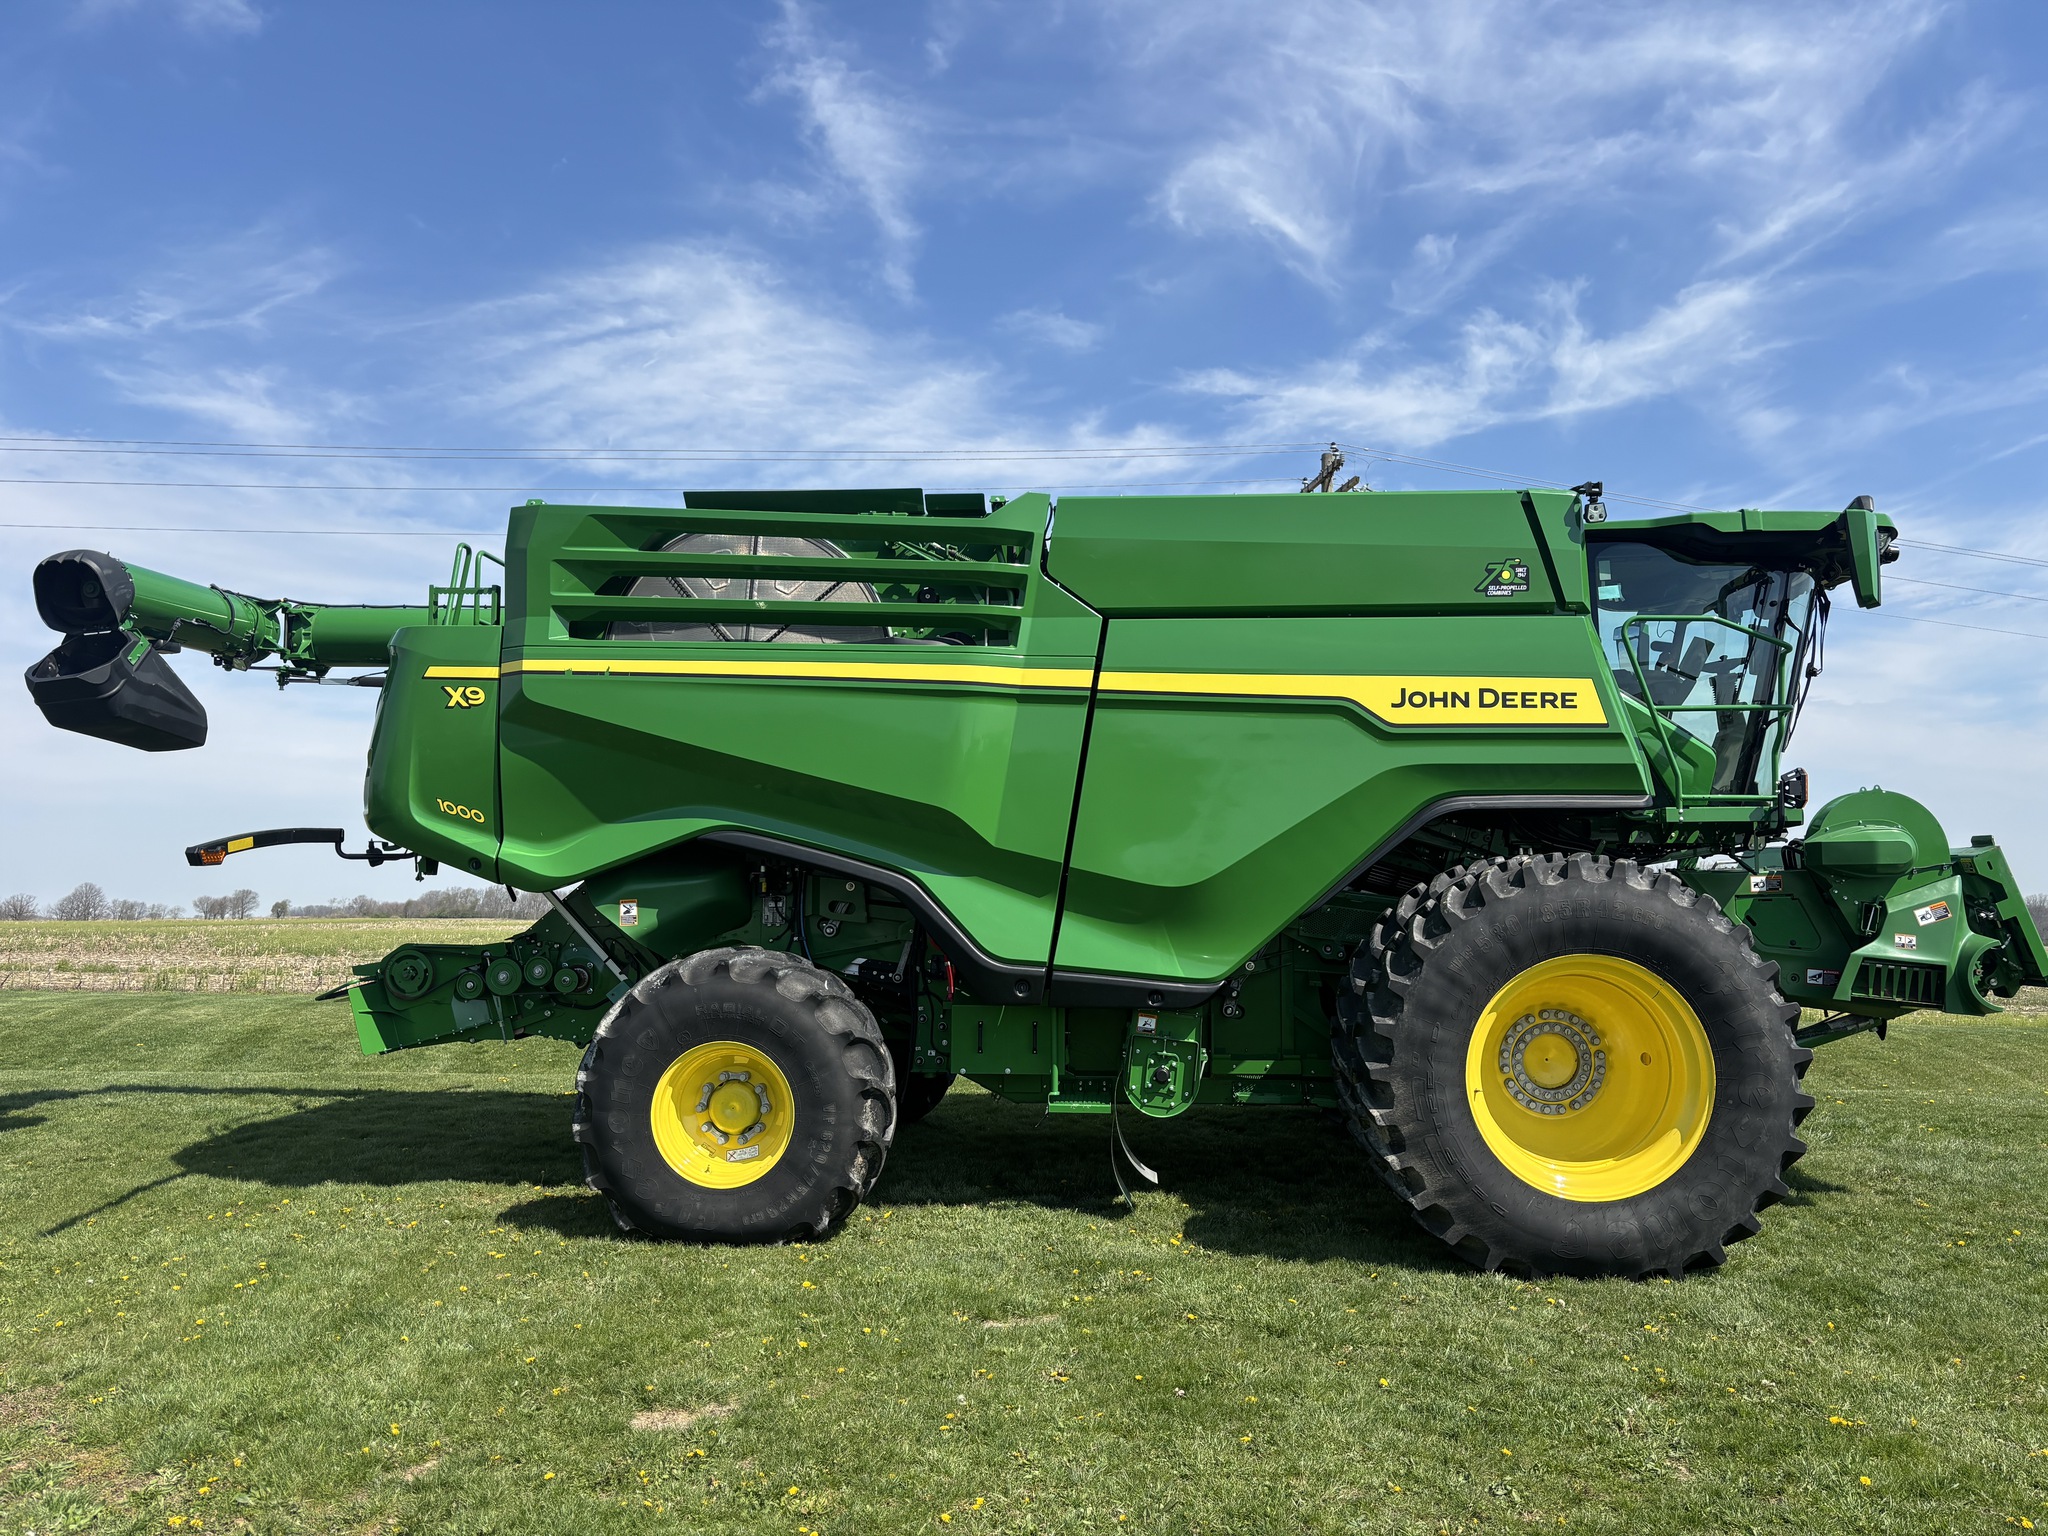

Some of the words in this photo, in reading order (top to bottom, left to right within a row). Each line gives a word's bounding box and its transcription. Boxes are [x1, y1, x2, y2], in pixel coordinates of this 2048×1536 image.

[1478, 559, 1520, 590] 75
[441, 686, 486, 709] X9
[1391, 688, 1470, 708] JOHN
[1479, 688, 1578, 708] DEERE
[436, 798, 485, 823] 1000
